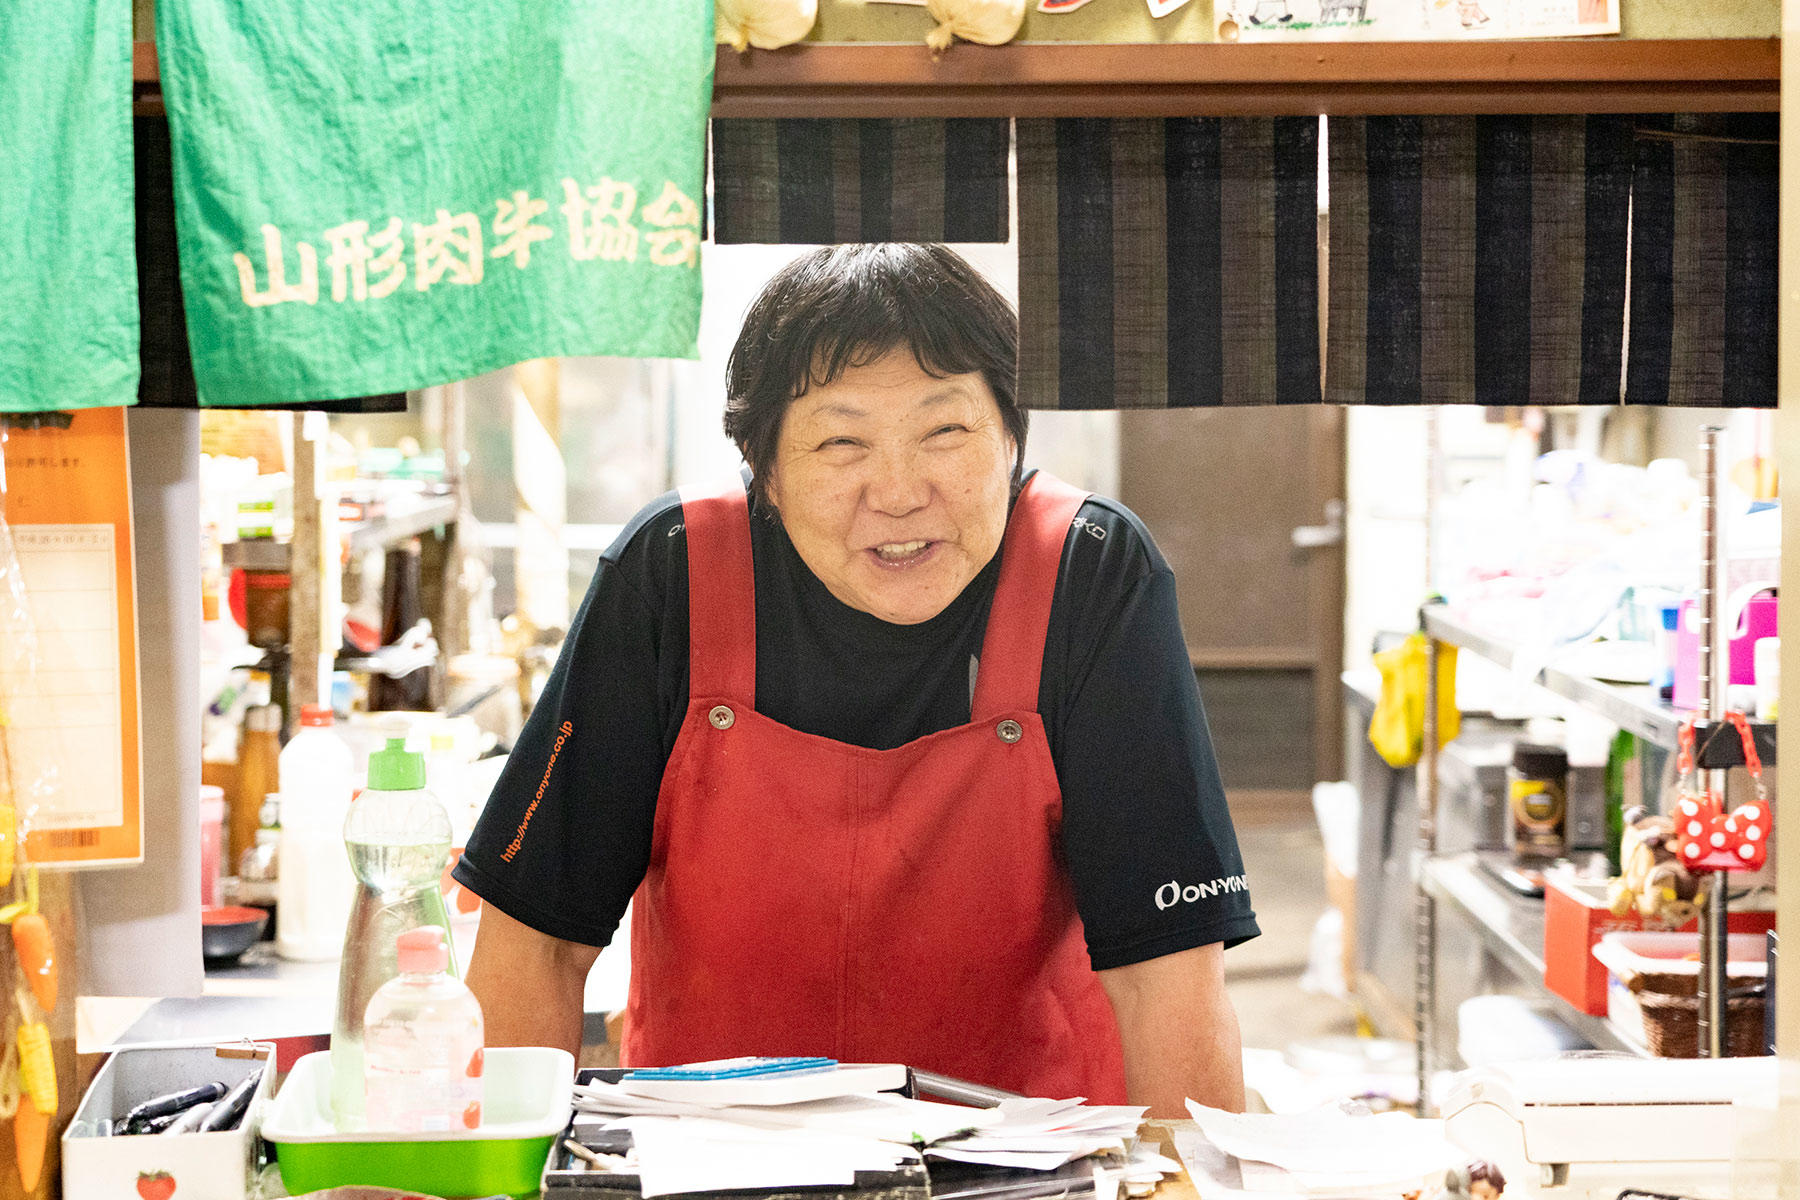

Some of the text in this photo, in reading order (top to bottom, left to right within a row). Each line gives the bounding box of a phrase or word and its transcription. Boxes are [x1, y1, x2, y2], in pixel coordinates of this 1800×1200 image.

[233, 176, 698, 307] 山形肉牛協会
[500, 720, 573, 863] http://www.onyone.co.jp
